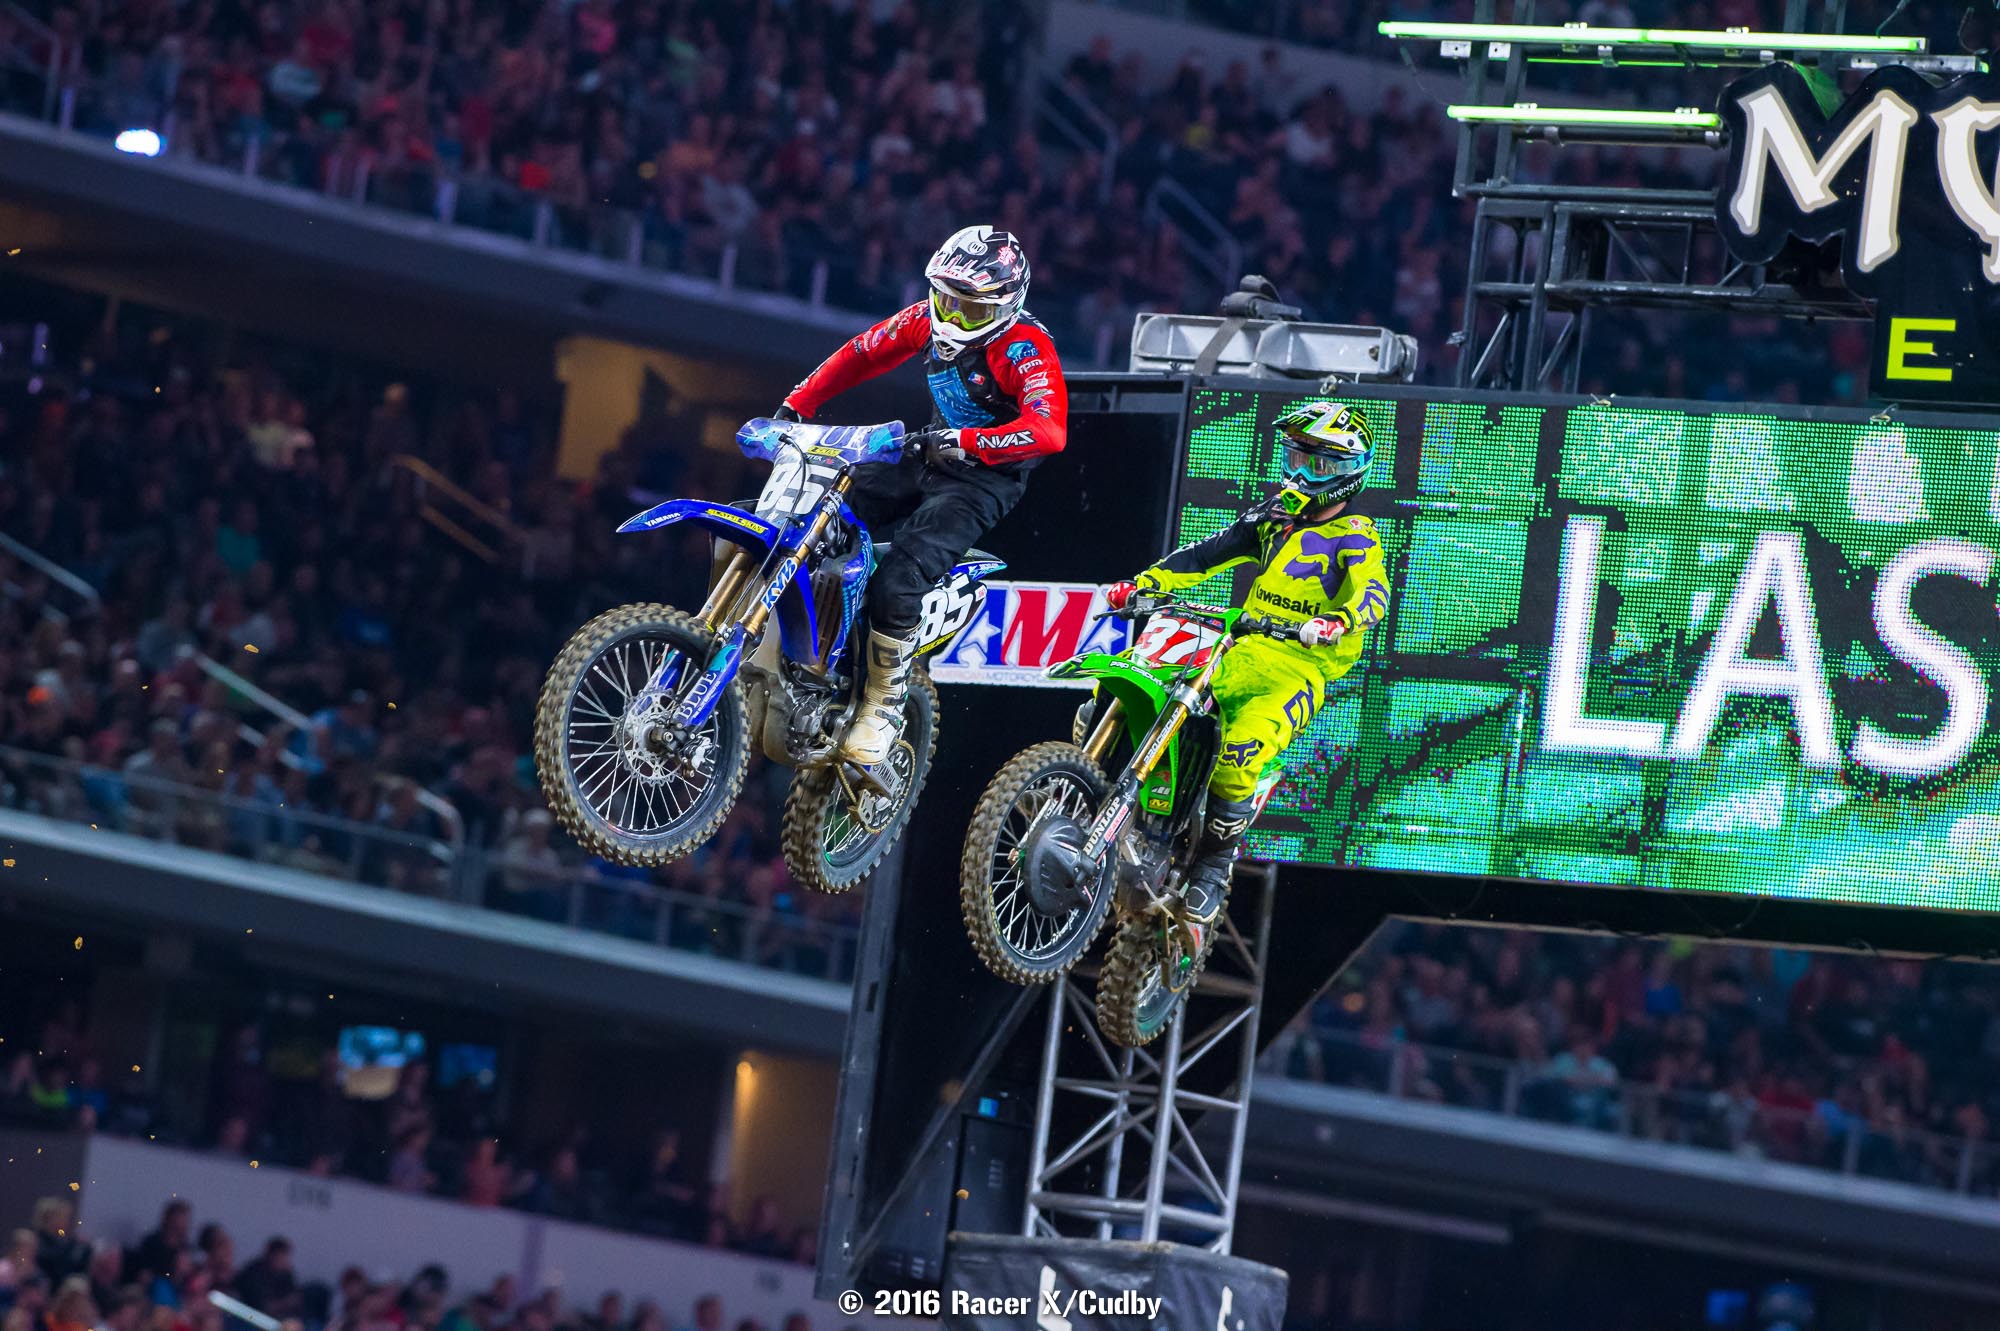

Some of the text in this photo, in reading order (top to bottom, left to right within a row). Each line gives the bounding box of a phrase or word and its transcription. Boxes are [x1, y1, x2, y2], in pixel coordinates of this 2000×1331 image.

[756, 462, 840, 516] 85
[644, 512, 681, 527] YAMAHA
[919, 573, 974, 646] 85
[942, 588, 1131, 667] AMA
[678, 672, 717, 719] BLUE
[1083, 796, 1120, 856] DUNLOP
